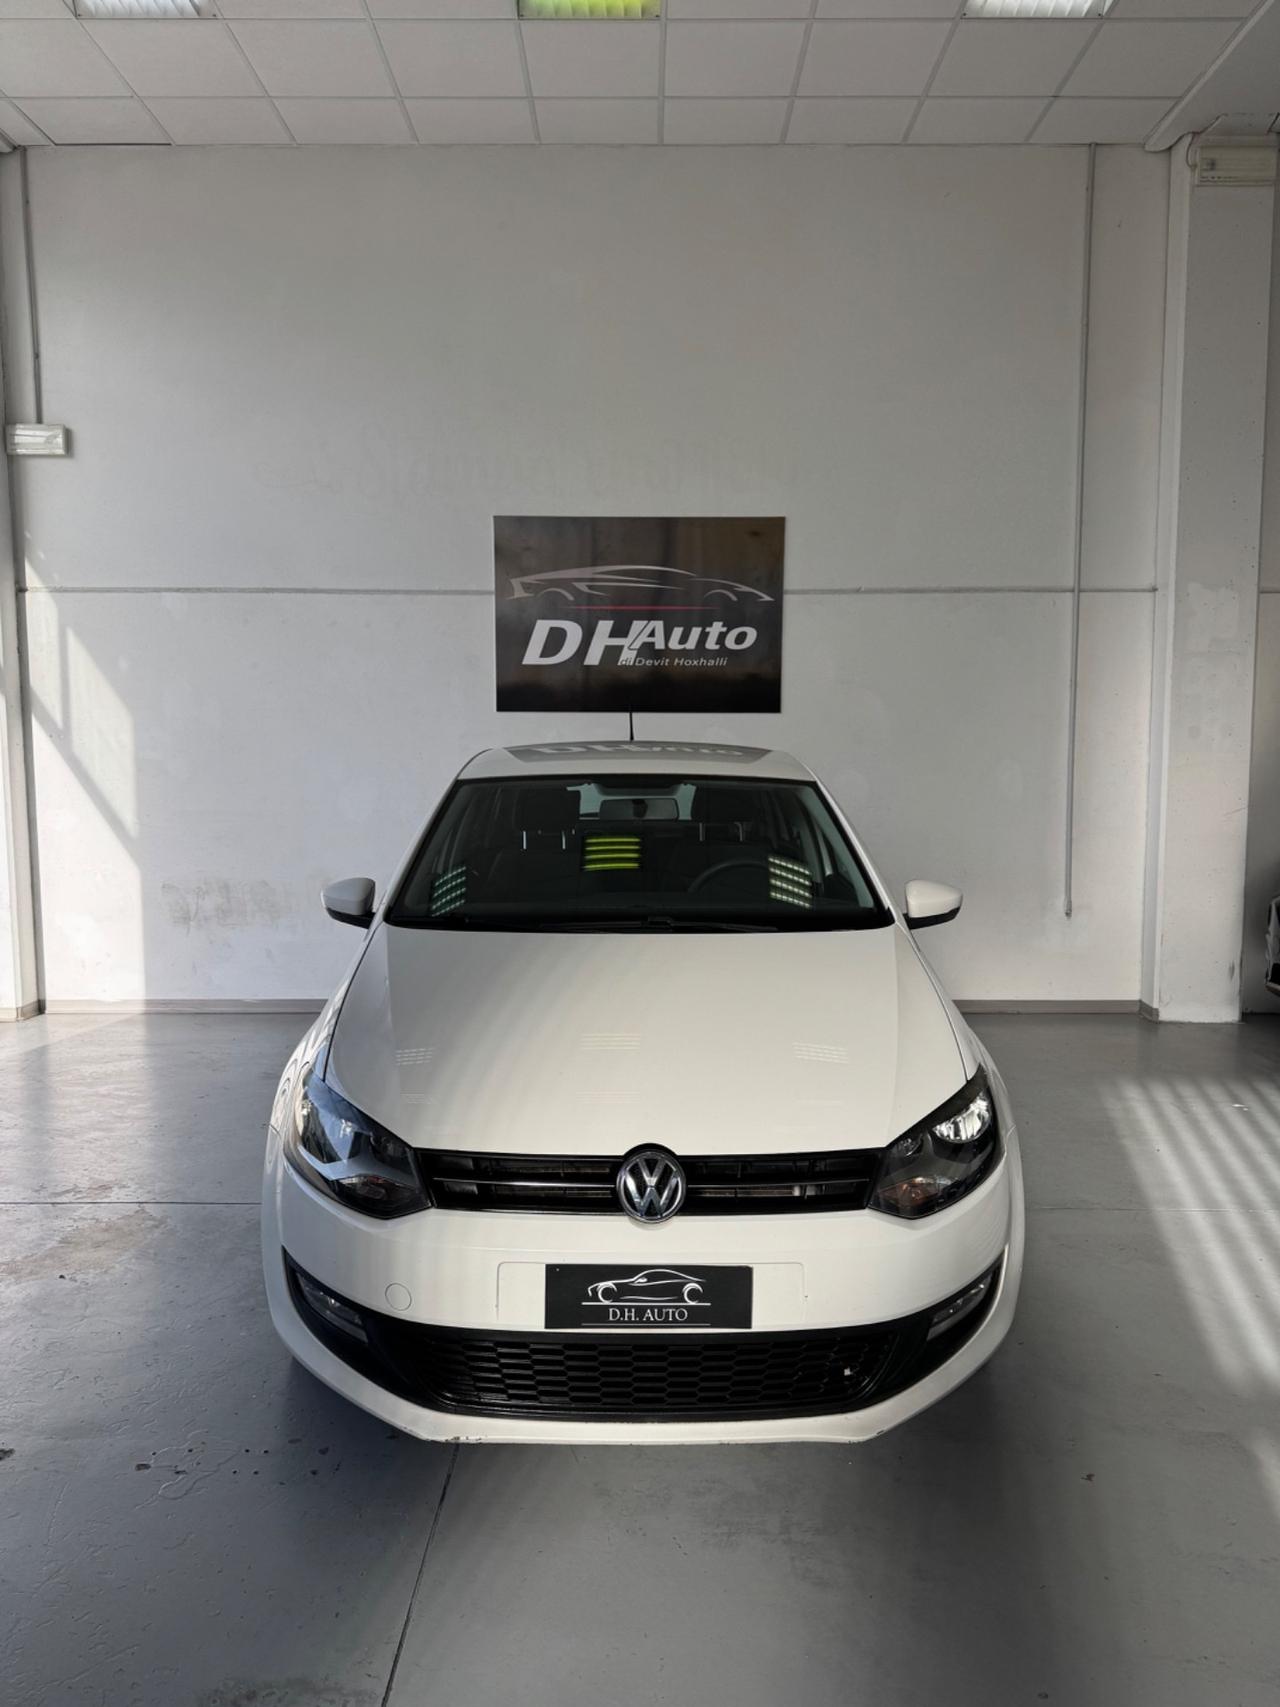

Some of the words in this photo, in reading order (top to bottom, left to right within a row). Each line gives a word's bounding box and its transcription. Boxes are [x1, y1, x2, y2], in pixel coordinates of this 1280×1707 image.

[635, 657, 670, 667] Devit
[673, 657, 728, 667] Hoxhalli
[608, 1308, 640, 1322] D.H.
[642, 1308, 688, 1322] AUTO
